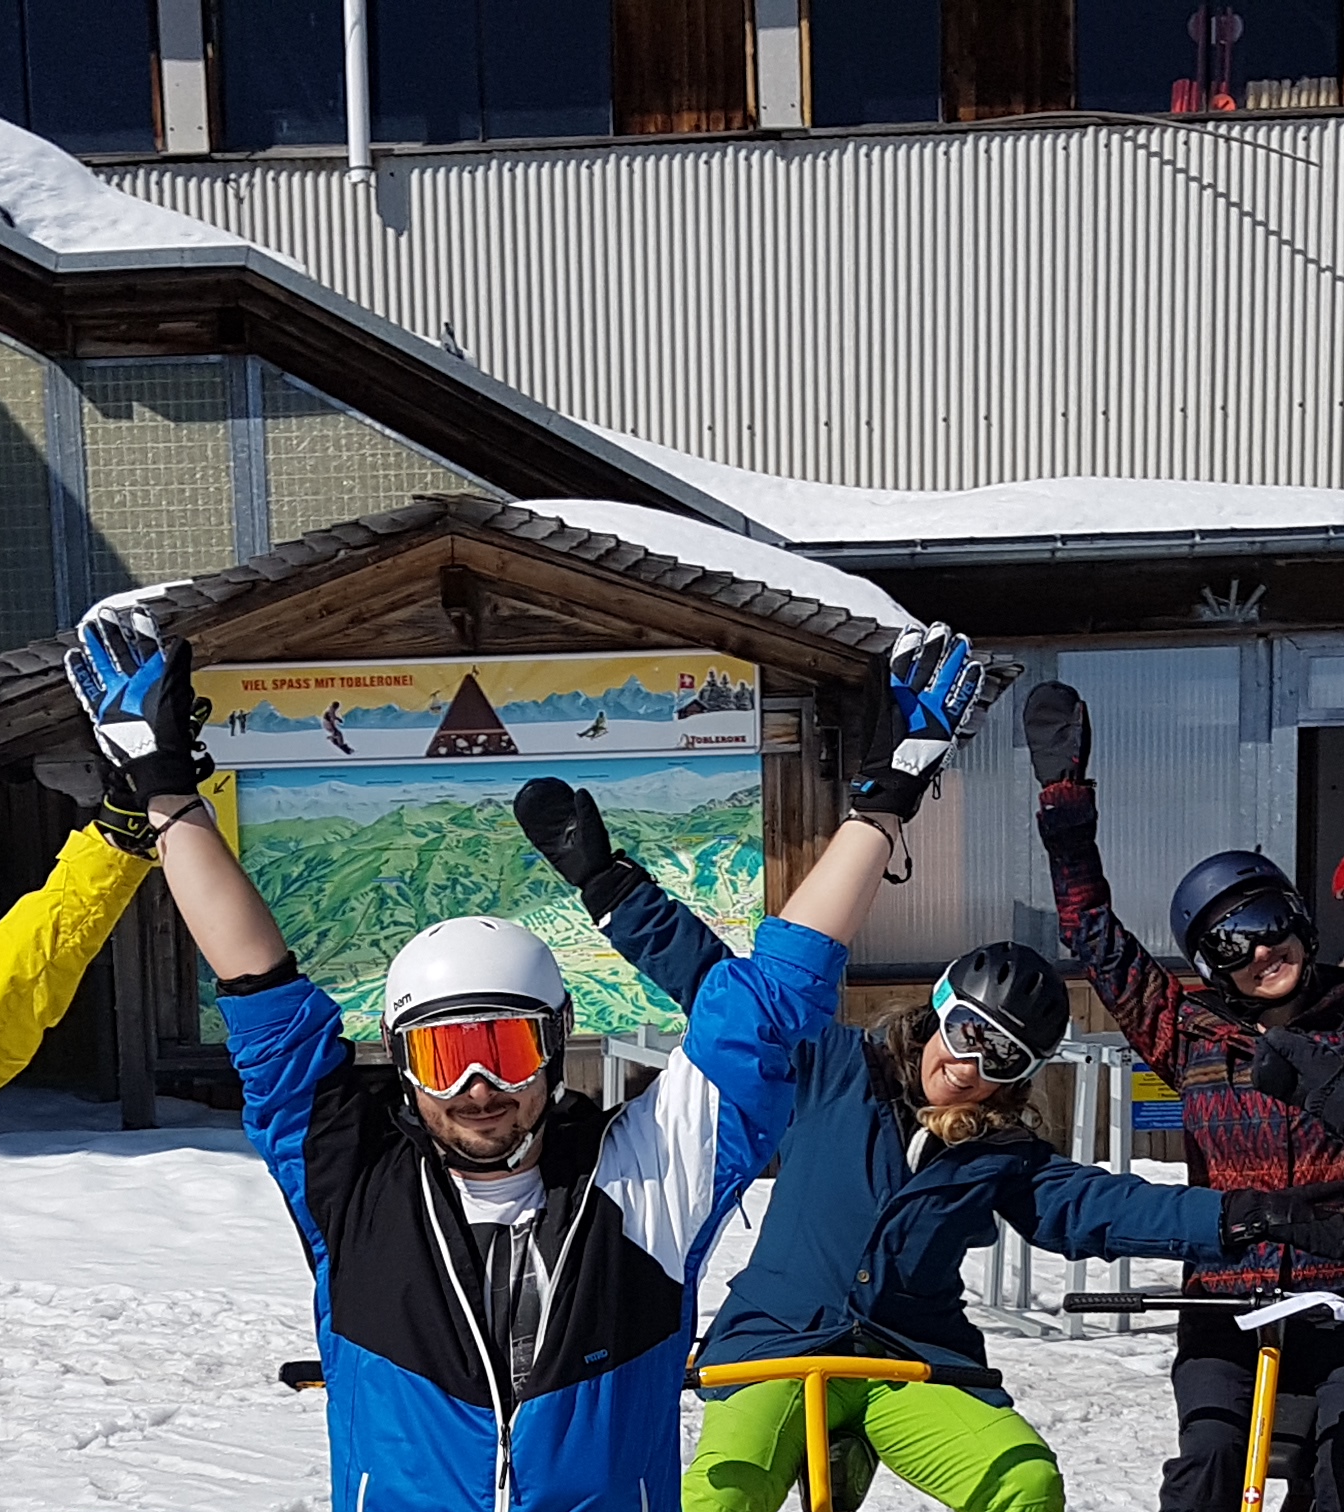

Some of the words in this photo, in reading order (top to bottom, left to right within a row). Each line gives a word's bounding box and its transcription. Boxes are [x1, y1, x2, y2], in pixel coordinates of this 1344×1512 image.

[73, 663, 101, 702] LEVEL
[242, 679, 268, 692] VIEL
[272, 678, 311, 690] SPASS
[315, 677, 336, 689] MIT
[340, 675, 414, 688] TOBLERONE!
[947, 680, 977, 717] LEVEL
[393, 993, 412, 1011] bern
